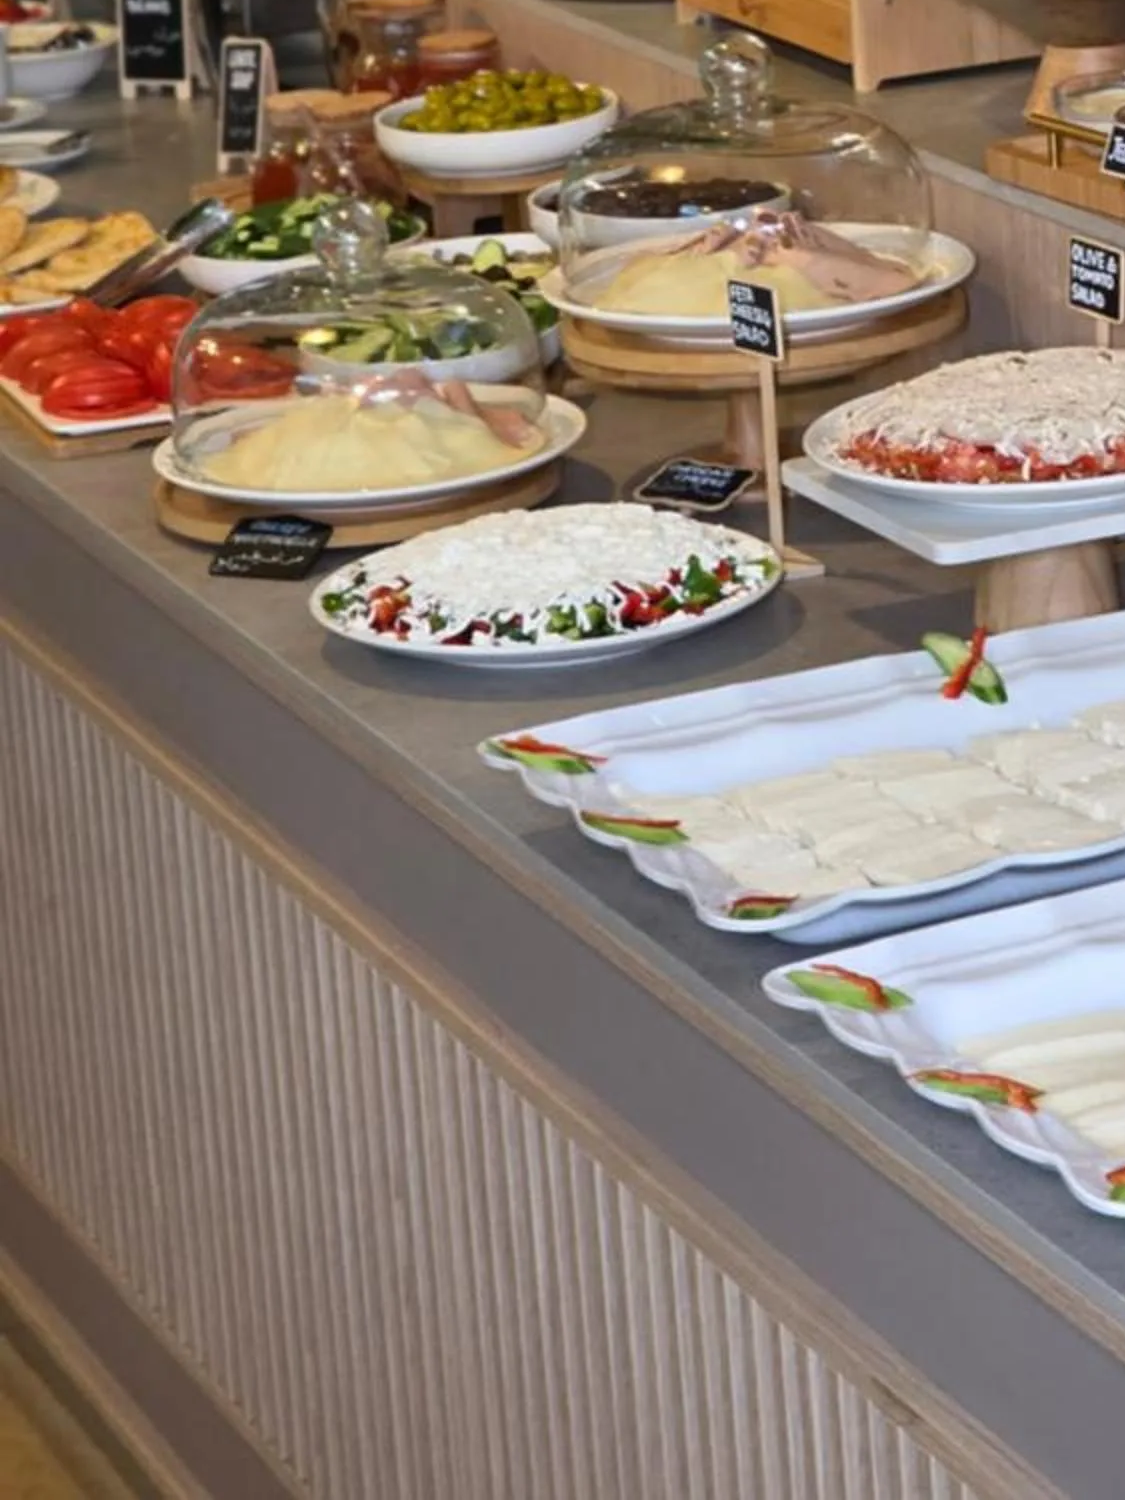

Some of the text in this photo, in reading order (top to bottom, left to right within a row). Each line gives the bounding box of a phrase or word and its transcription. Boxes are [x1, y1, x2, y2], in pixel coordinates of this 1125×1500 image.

[1072, 243, 1118, 274] OLIVE &
[1071, 263, 1116, 290] TOMATO
[1071, 281, 1106, 309] SALAD
[731, 320, 770, 346] SALAD
